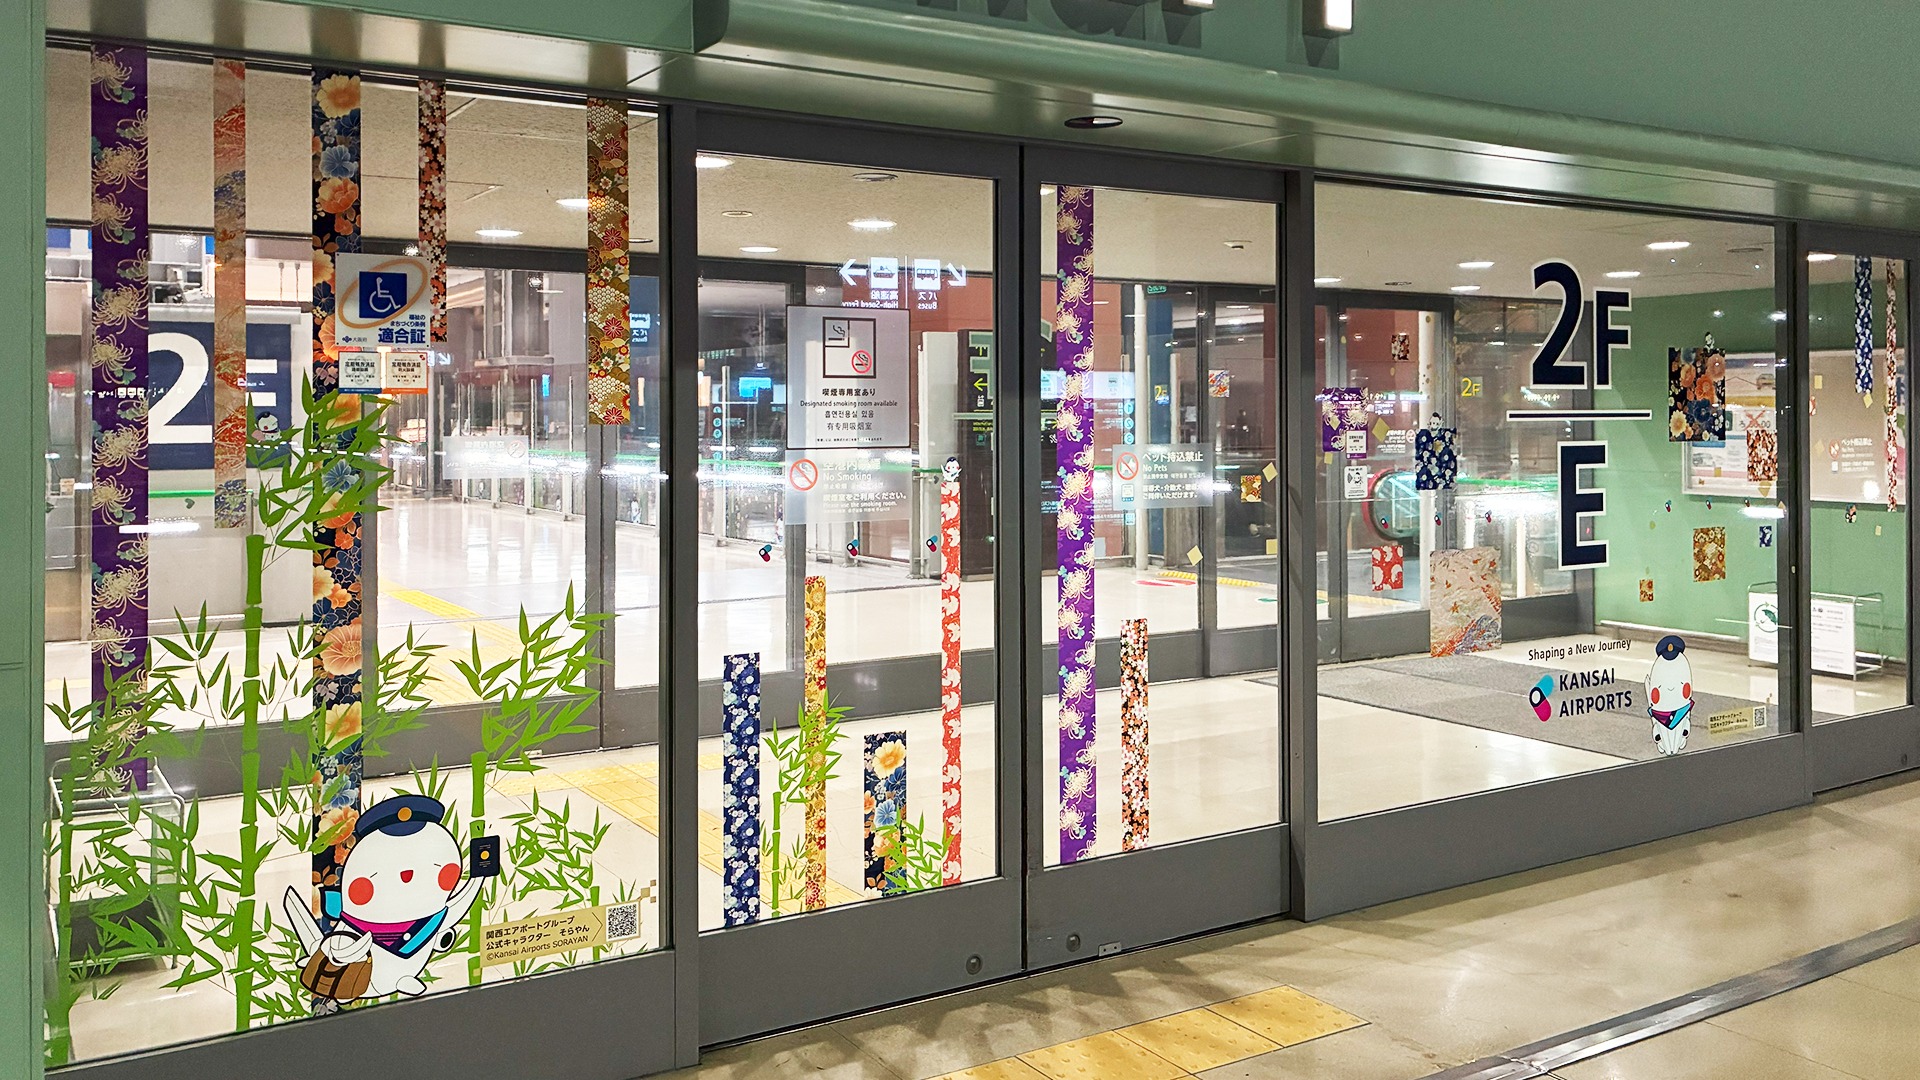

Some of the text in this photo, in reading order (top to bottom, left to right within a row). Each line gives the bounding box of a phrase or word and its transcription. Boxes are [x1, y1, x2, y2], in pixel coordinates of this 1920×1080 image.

[1530, 258, 1632, 389] 2F
[378, 327, 426, 344] 適合証
[822, 388, 876, 396] 喫煙専用室あり
[1461, 377, 1481, 397] 2F
[800, 400, 832, 408] Designated
[833, 400, 857, 408] smoking
[1142, 451, 1204, 462] ペット持込禁止
[823, 472, 872, 482] No Smoking
[1142, 463, 1168, 472] No Pets
[1557, 440, 1609, 571] E
[1528, 639, 1632, 661] Shaping a New Journey
[1559, 668, 1615, 691] KANSAI
[1559, 690, 1632, 717] AIRPORTS
[486, 915, 575, 939] 関西エアポートグループ
[486, 925, 590, 950] 公式キャラクター そらやん
[521, 943, 551, 954] Airports
[552, 935, 588, 948] SORAYAN
